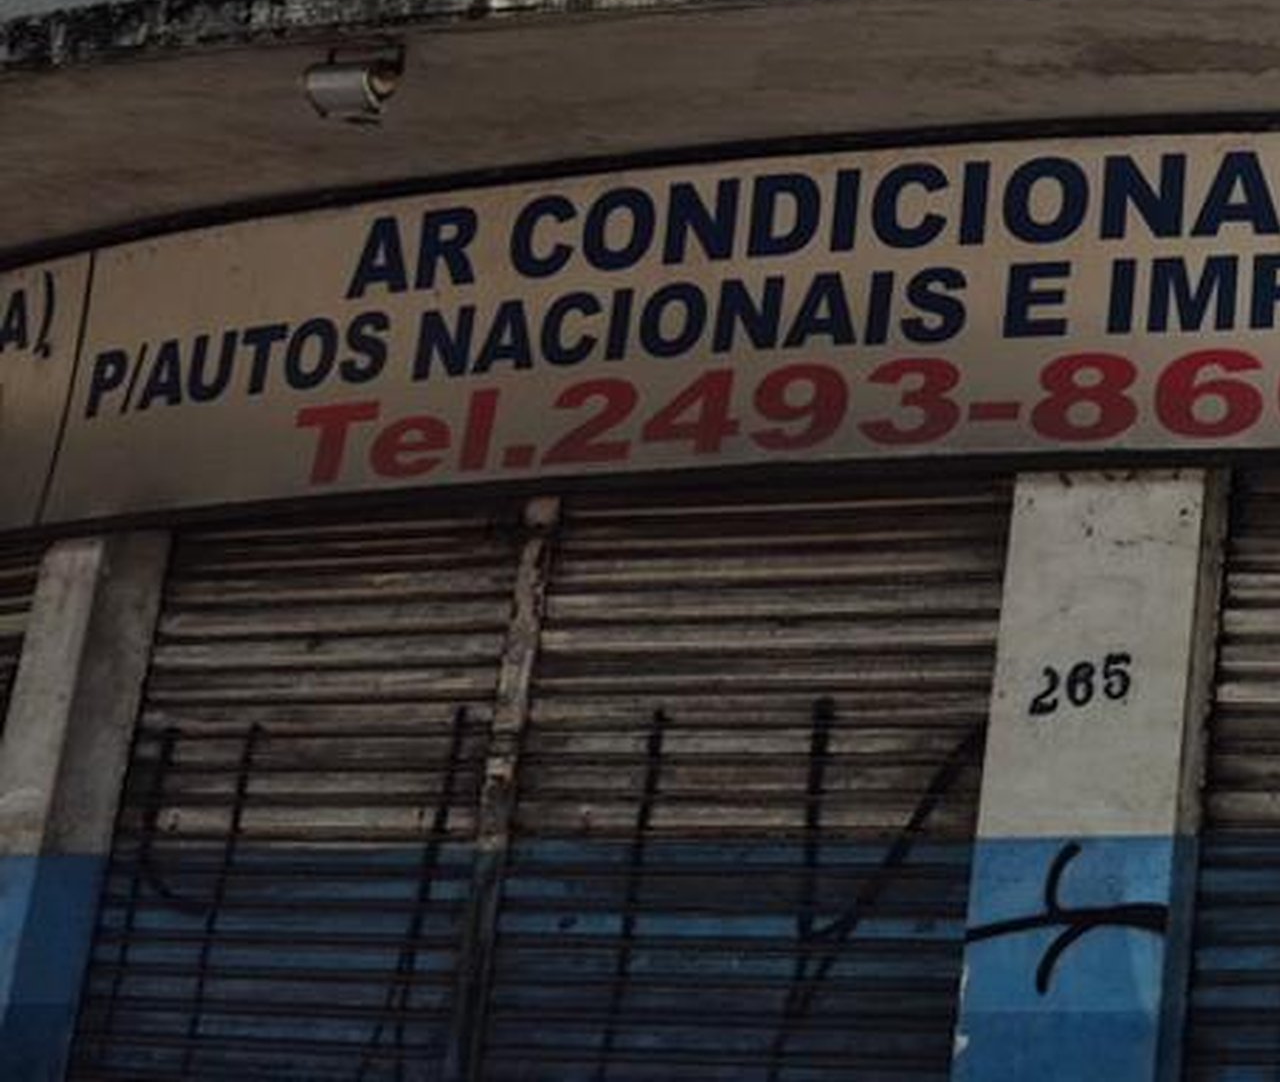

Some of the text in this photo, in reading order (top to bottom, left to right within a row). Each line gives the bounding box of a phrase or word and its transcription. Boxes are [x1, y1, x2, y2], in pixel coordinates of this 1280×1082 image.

[346, 206, 479, 299] AR
[85, 310, 390, 418] P/AUTOS
[411, 265, 968, 381] NACIONAIS
[1003, 260, 1072, 338] E
[1028, 650, 1132, 716] 265
